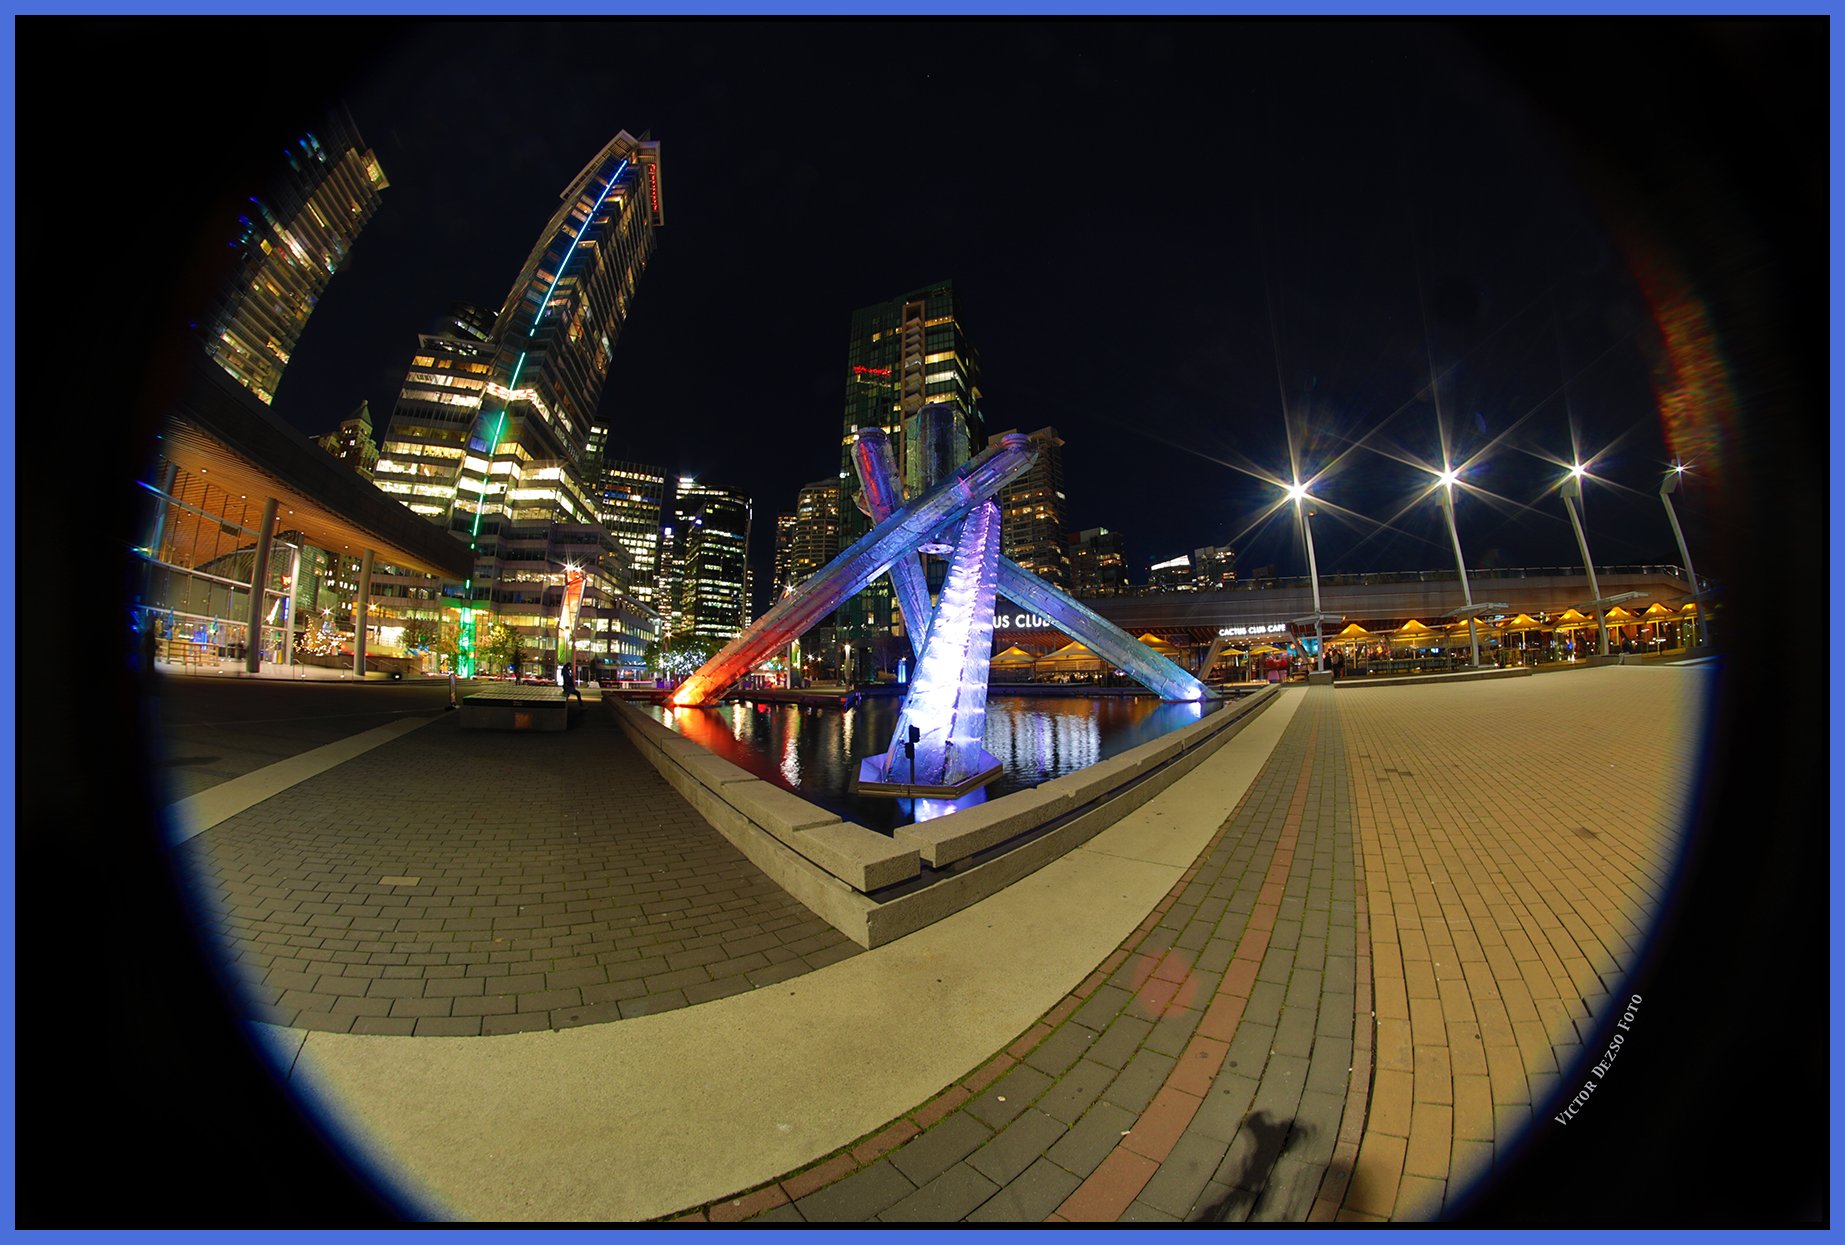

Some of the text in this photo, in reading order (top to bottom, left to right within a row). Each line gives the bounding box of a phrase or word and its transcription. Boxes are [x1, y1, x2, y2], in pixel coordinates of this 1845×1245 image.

[1218, 624, 1286, 636] CACTUS CLUB CAFE
